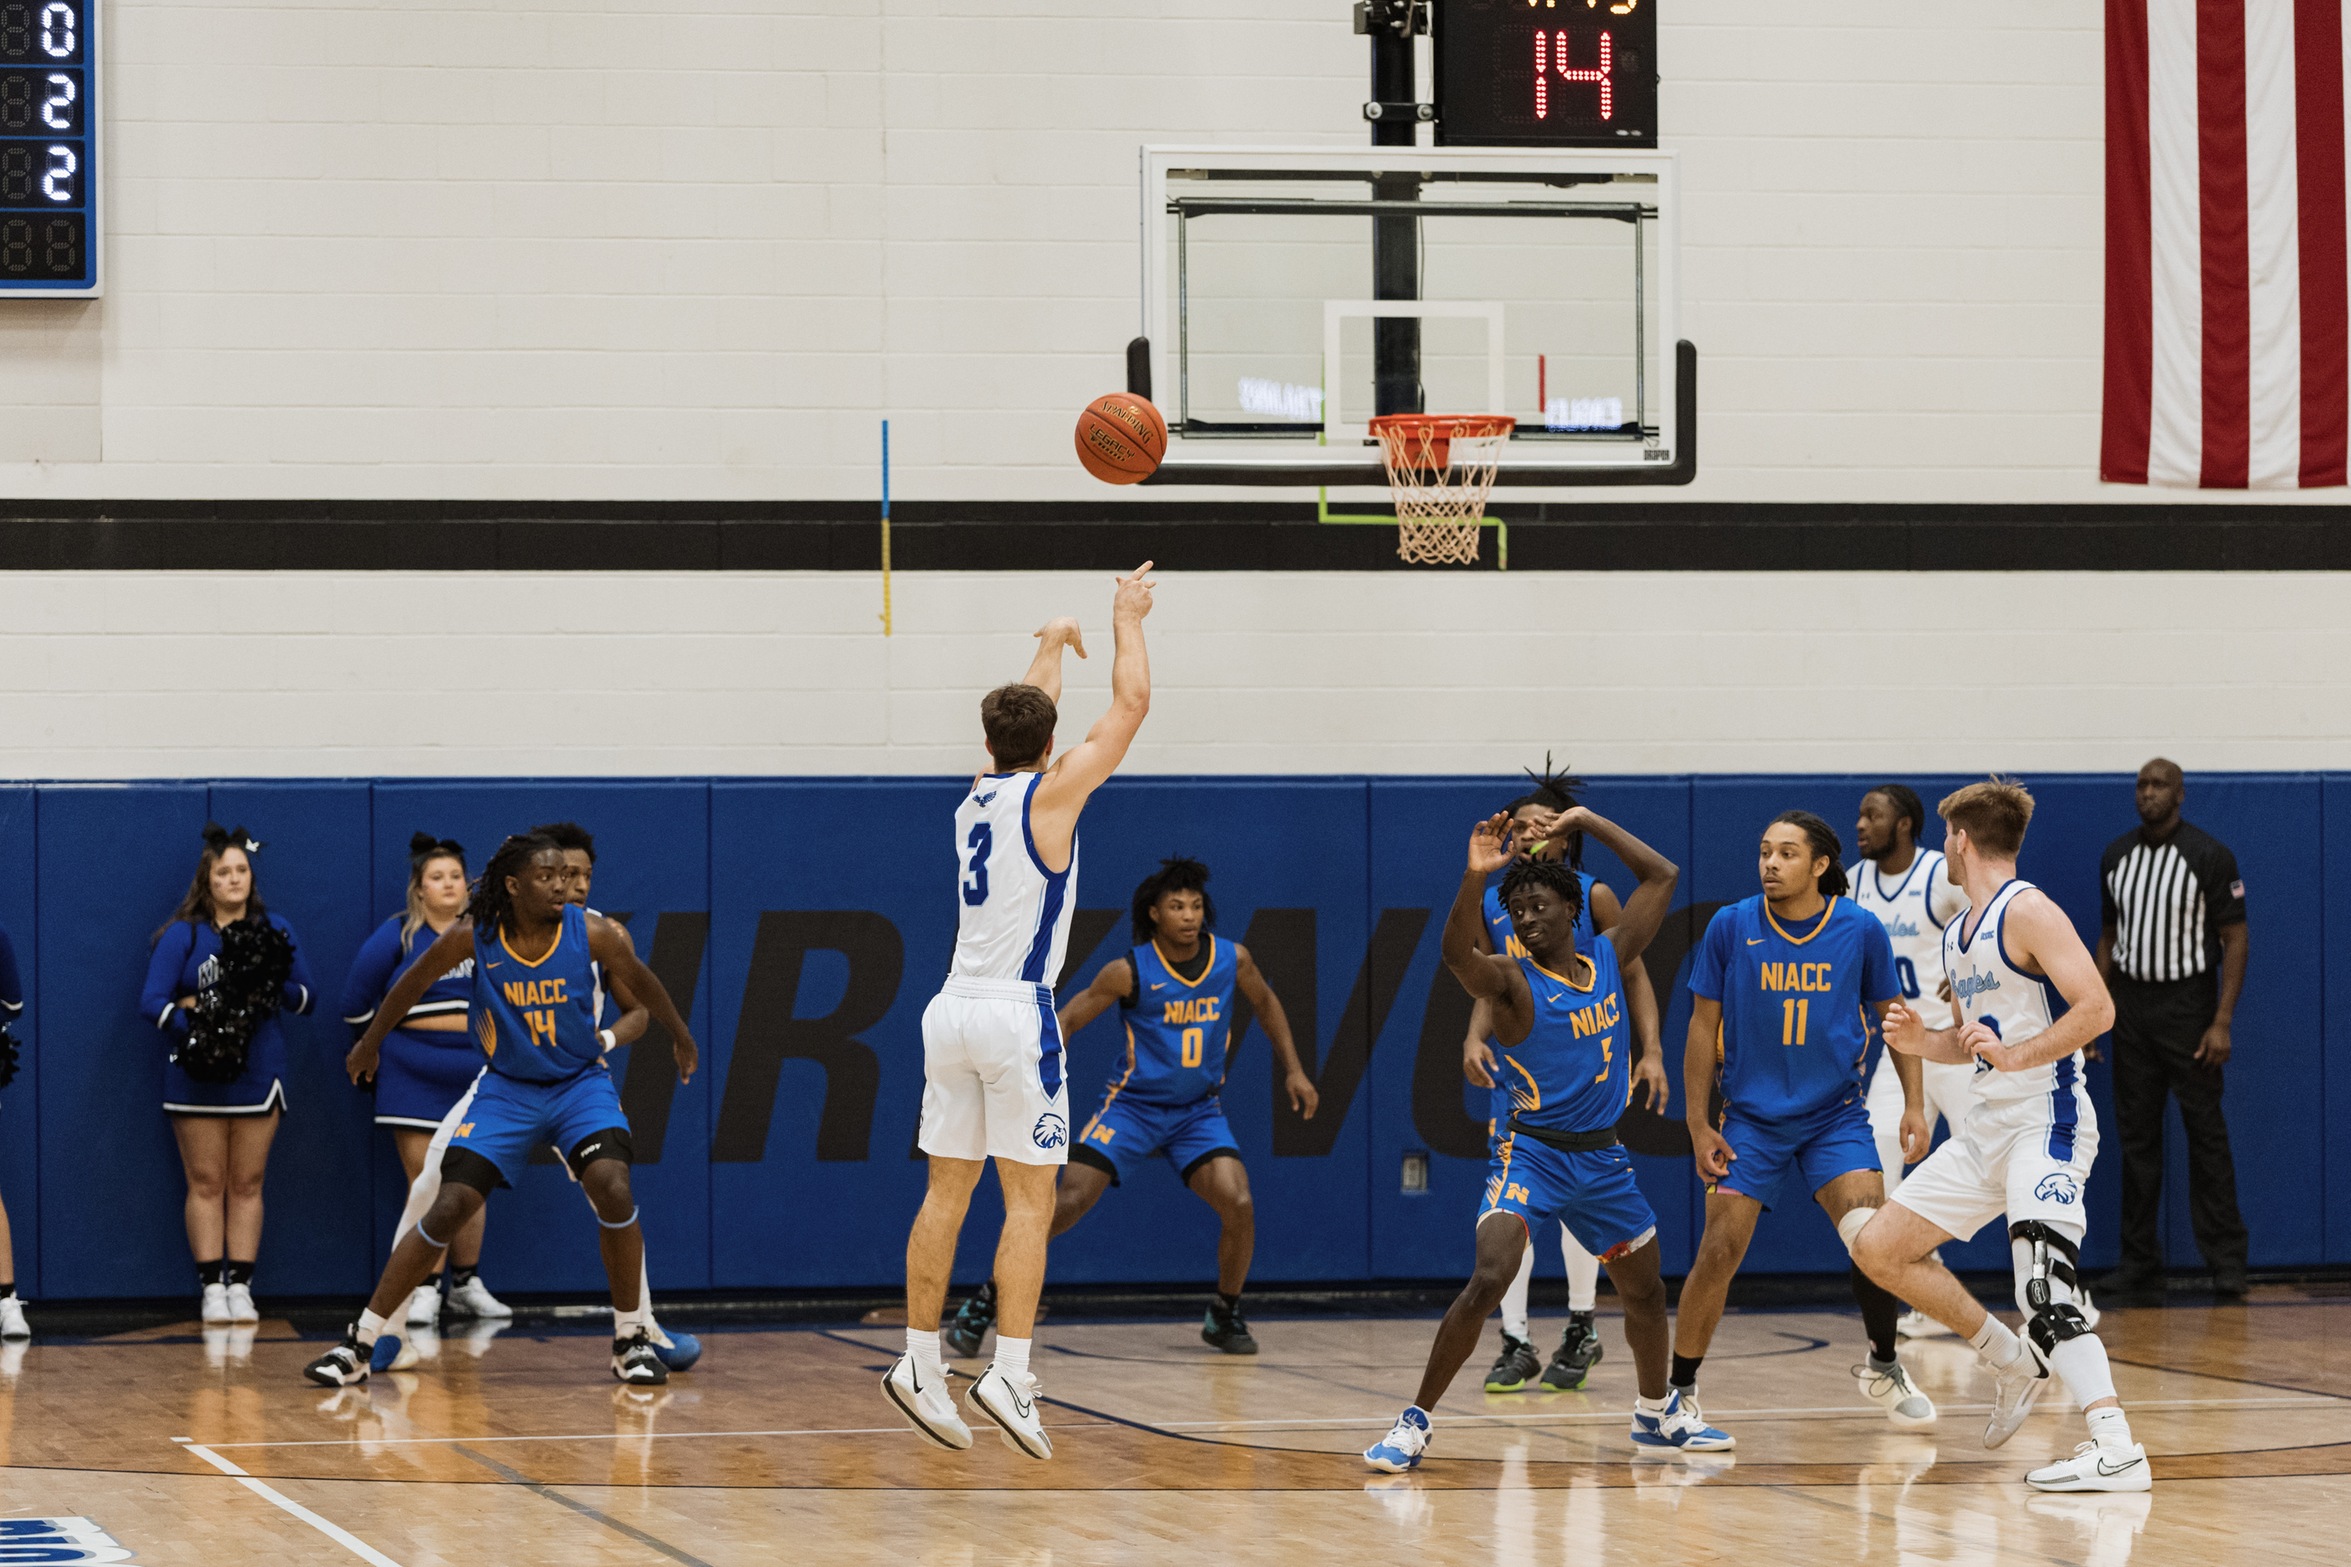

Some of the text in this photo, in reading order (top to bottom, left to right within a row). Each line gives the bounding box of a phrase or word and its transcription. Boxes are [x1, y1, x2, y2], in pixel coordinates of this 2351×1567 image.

[41, 2, 75, 57] 0
[1535, 30, 1612, 120] 14
[41, 74, 76, 129] 2
[41, 145, 76, 201] 2
[1089, 422, 1136, 459] LEGACY
[1101, 400, 1154, 445] SPALDING
[962, 821, 993, 907] 3
[503, 978, 569, 1007] NIACC
[1761, 961, 1832, 992] NIACC
[523, 1009, 557, 1047] 14
[1163, 996, 1221, 1024] NIACC
[1782, 998, 1809, 1046] 11
[1181, 1027, 1204, 1068] 0
[1595, 1036, 1613, 1084] 5
